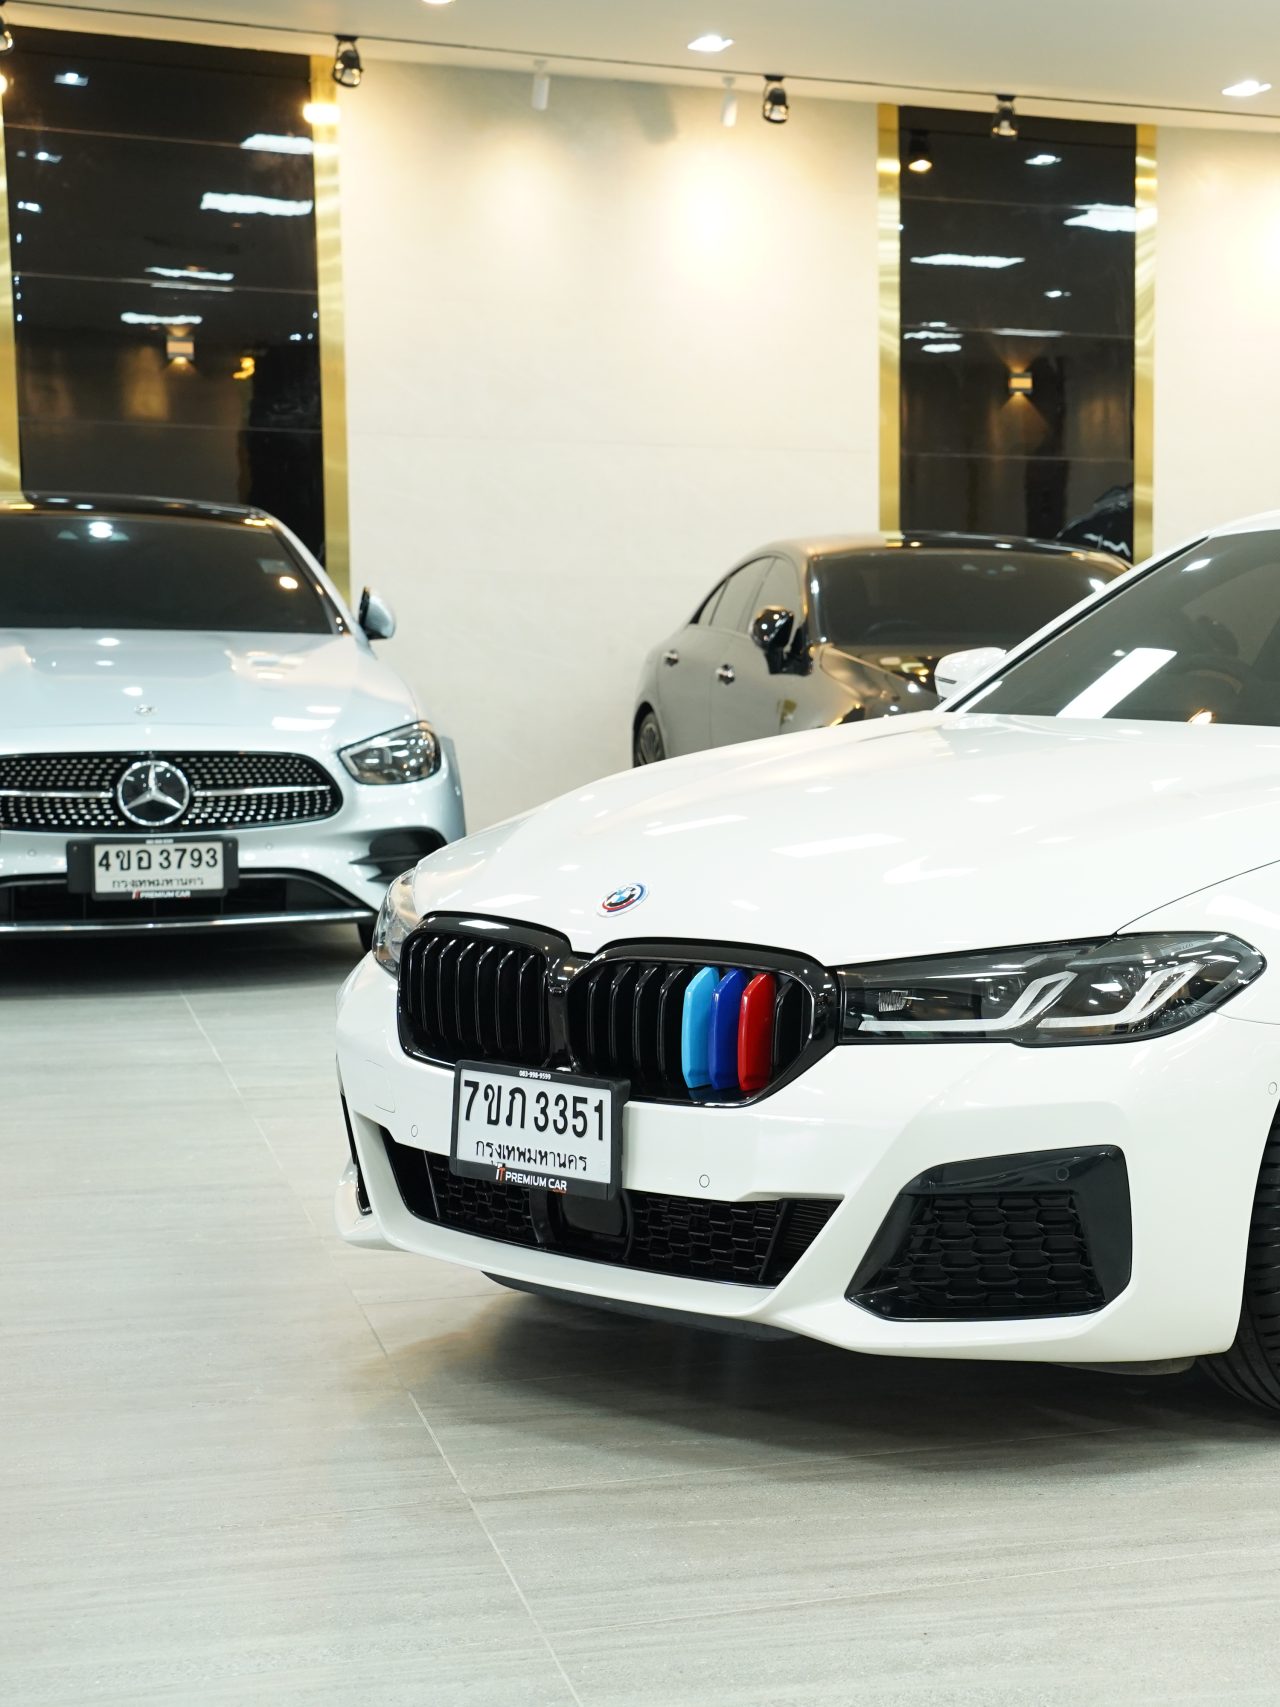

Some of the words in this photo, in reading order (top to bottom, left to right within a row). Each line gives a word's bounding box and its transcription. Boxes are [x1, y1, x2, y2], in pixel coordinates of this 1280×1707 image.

[159, 848, 218, 869] 3793
[464, 1079, 526, 1129] 7ขภ
[533, 1090, 604, 1141] 3351
[505, 1170, 547, 1188] PREMIUM
[548, 1178, 568, 1190] CAR
